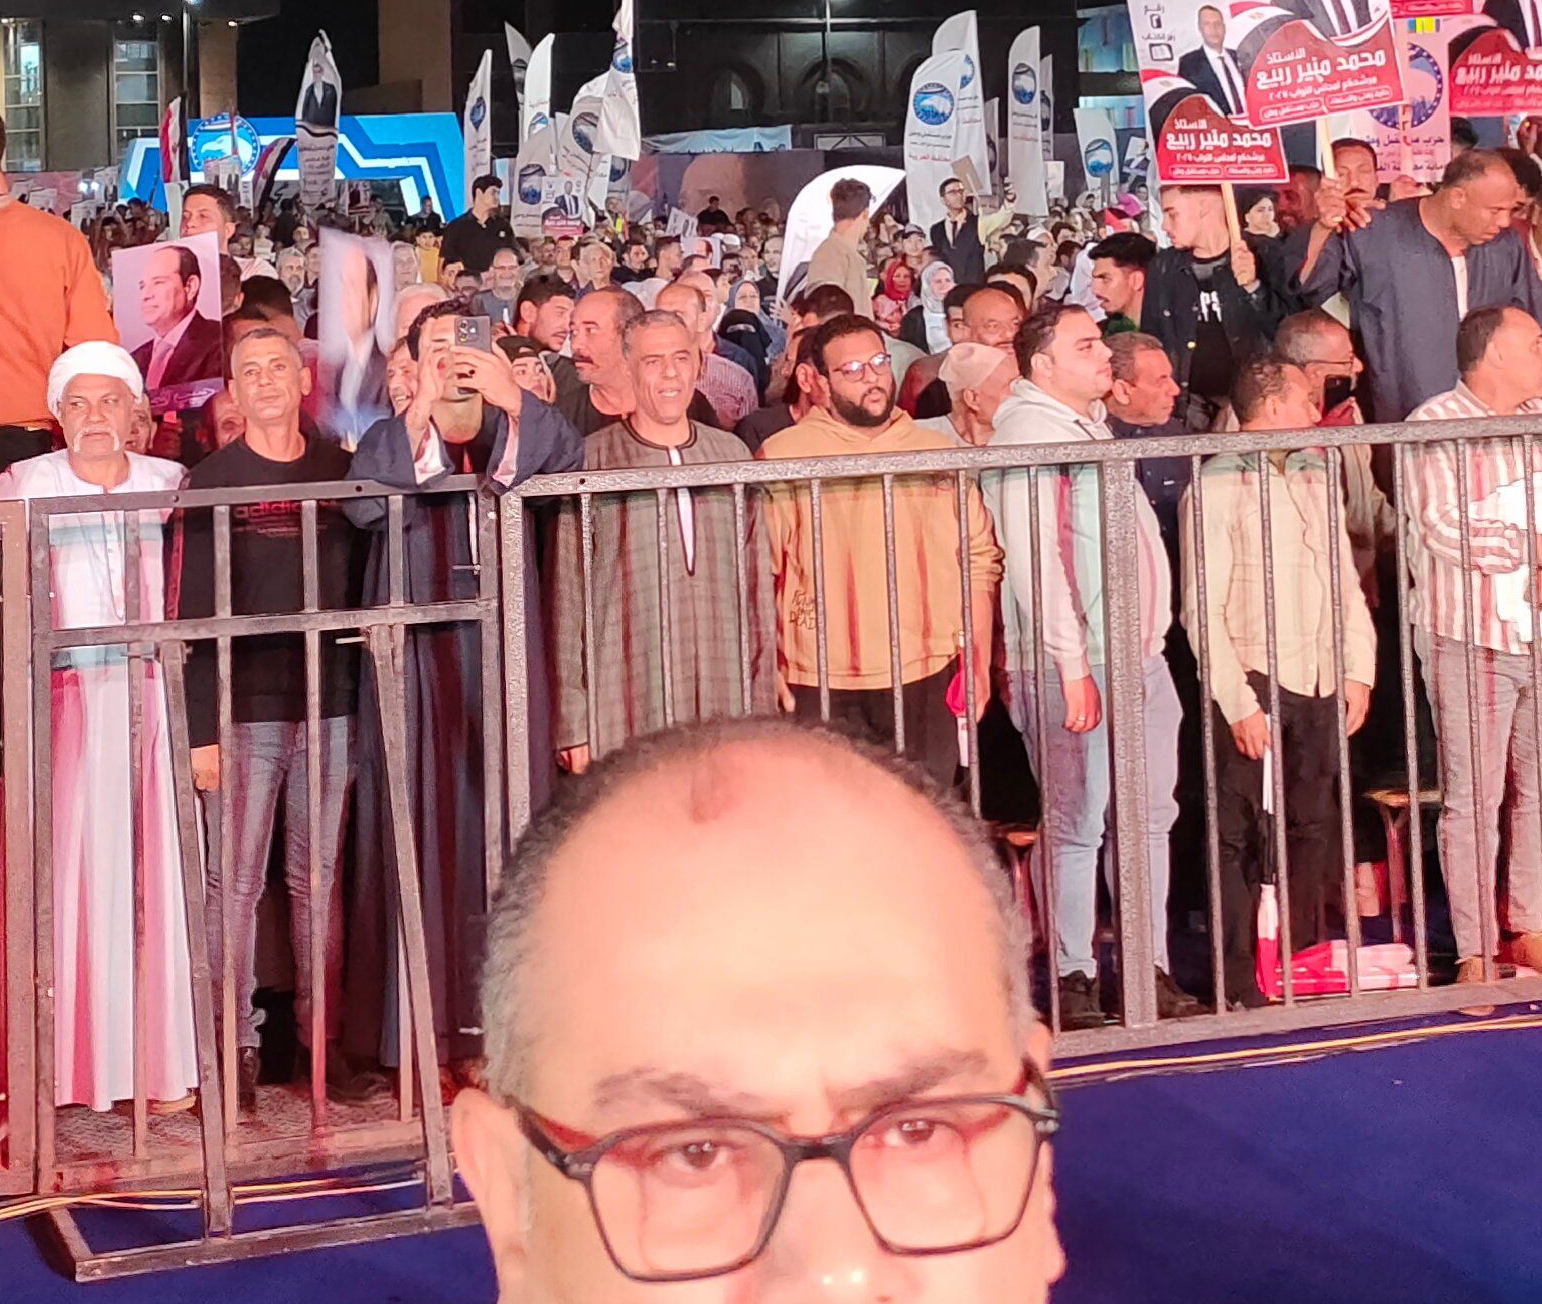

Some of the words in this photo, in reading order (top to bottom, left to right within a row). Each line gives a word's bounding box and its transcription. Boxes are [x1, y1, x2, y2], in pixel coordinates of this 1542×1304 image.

[1296, 56, 1331, 83] منير
[1336, 49, 1386, 71] محمد
[1256, 66, 1292, 89] ربيع
[1456, 64, 1486, 85] ربيع
[1490, 60, 1521, 84] منير
[1166, 131, 1196, 152] ربيع
[1199, 129, 1228, 152] منير
[1233, 132, 1272, 148] محمد
